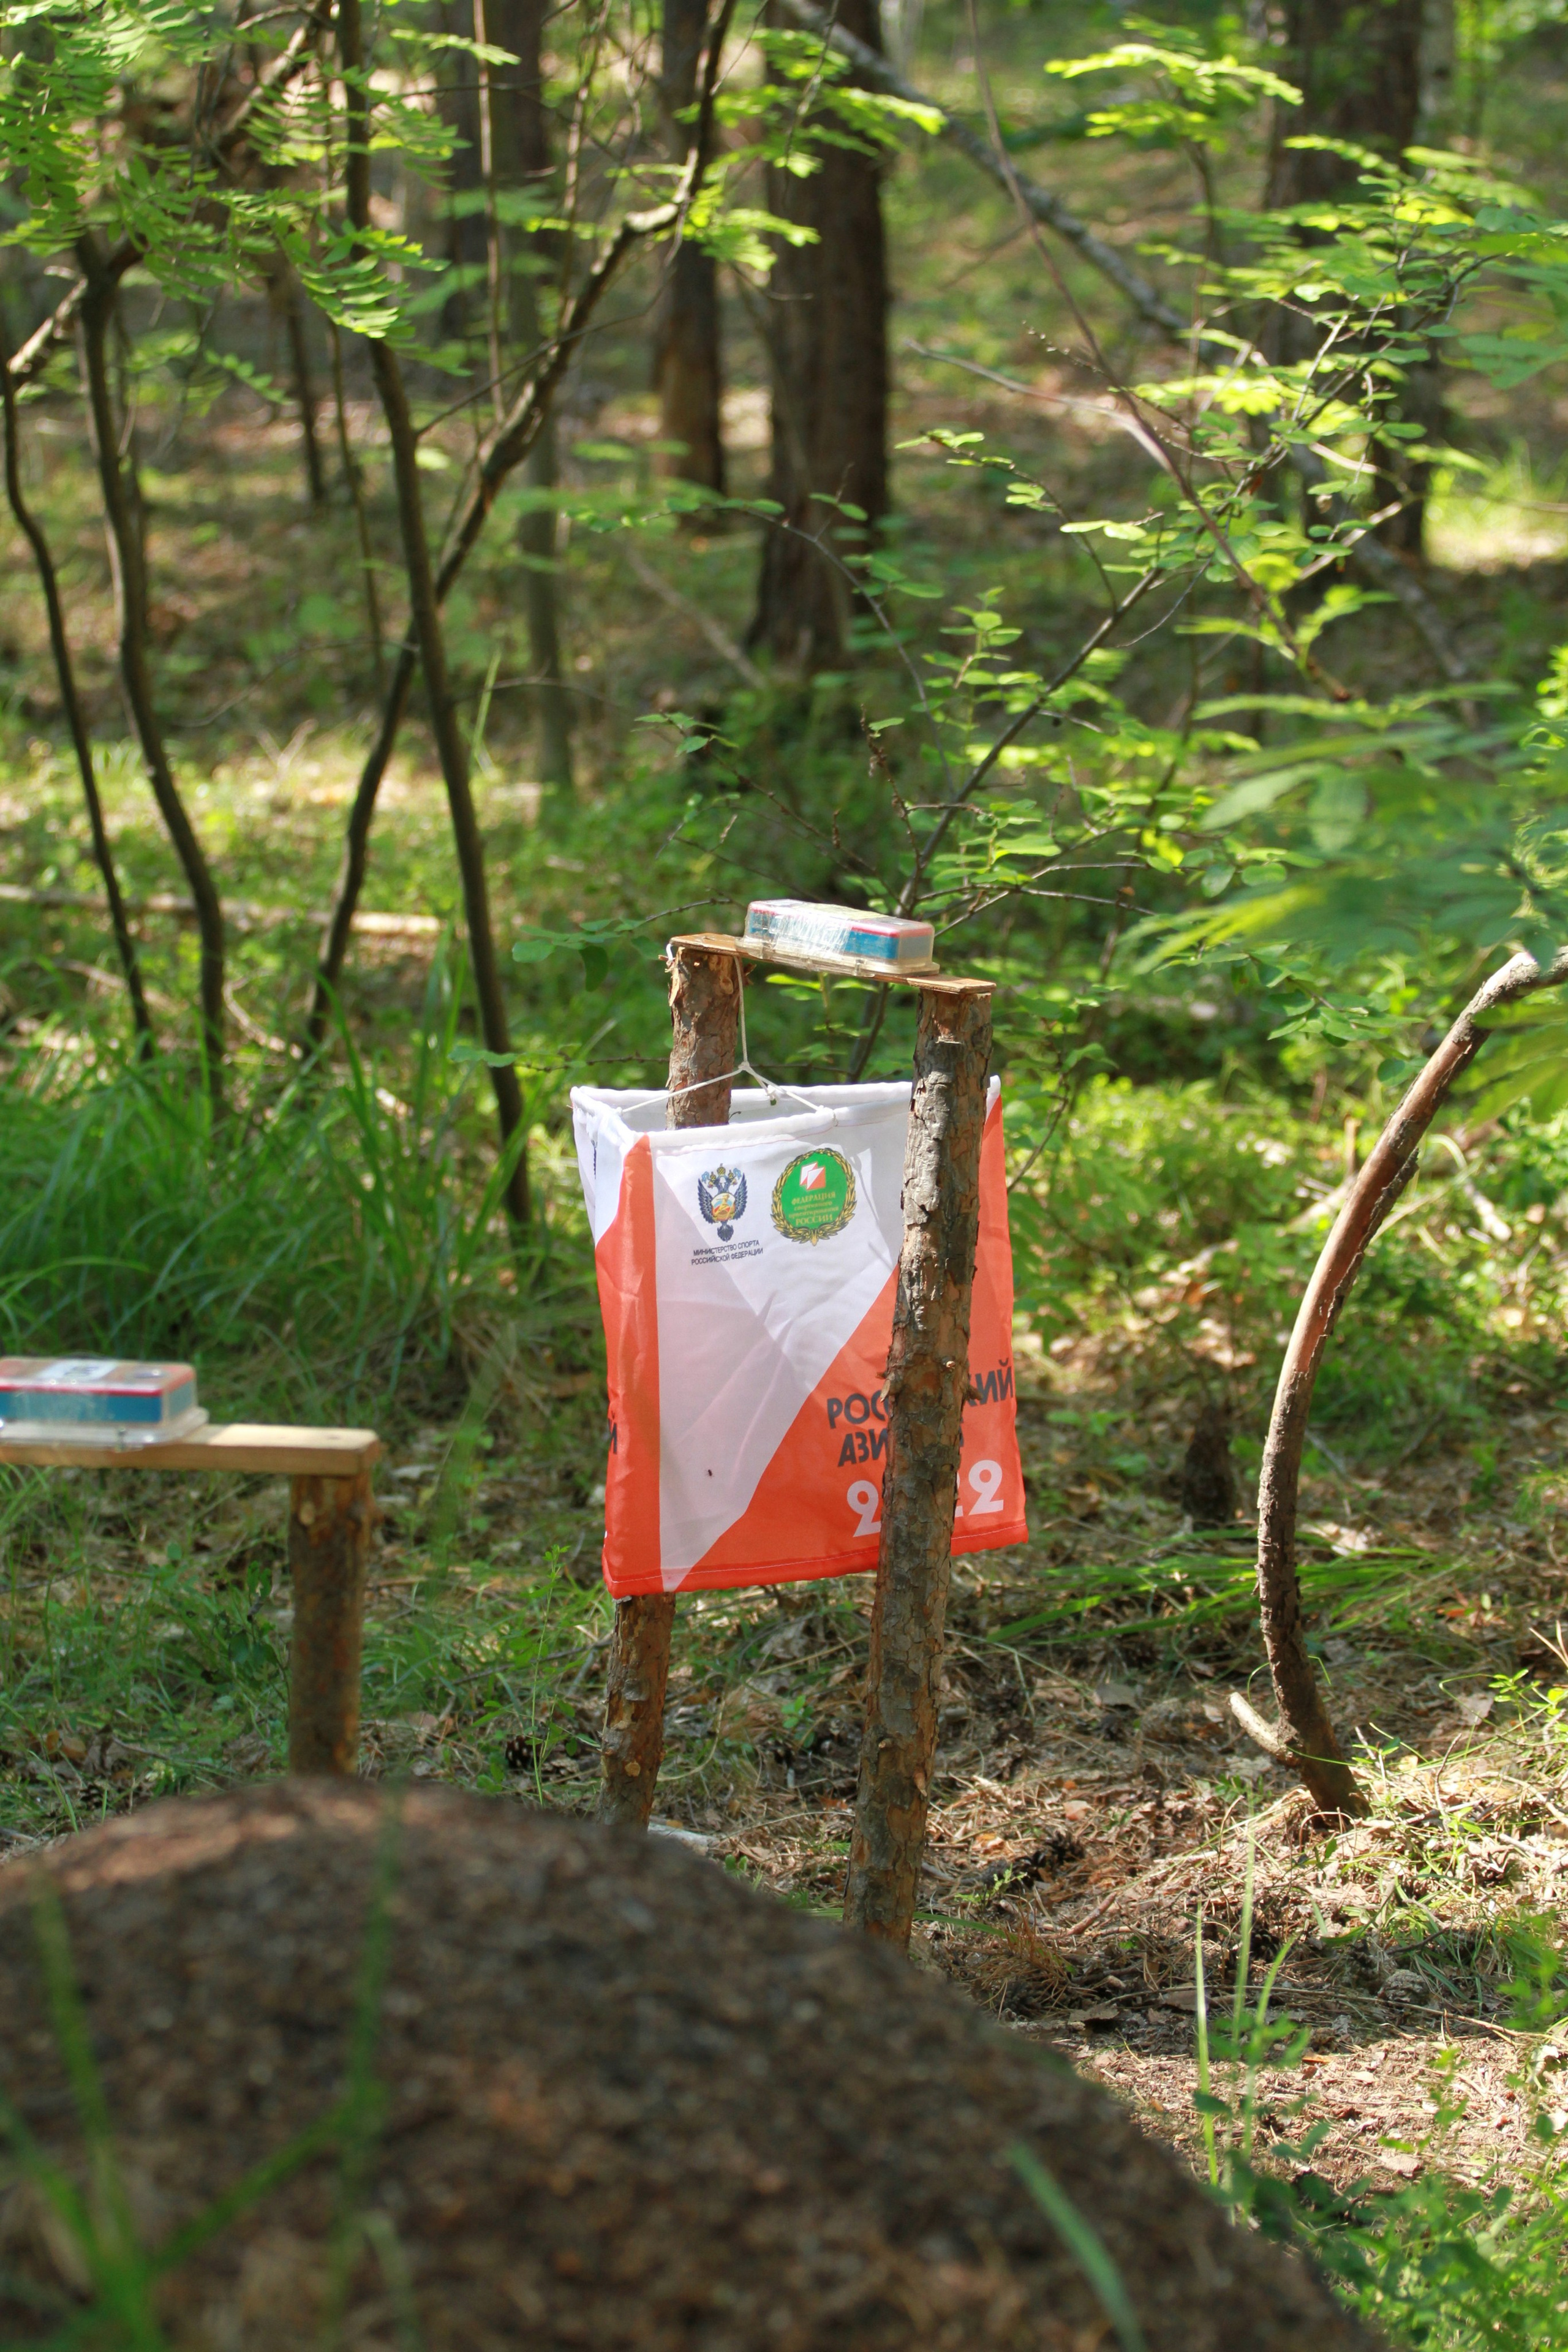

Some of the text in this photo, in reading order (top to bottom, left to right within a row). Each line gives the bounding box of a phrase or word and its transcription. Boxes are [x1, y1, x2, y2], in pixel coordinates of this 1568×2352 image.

[693, 1240, 760, 1256] МИНИСТЕРСТВО СПОРТА
[692, 1248, 763, 1265] РОССИЙСКОЙ ФЕДЕРАЦИИ
